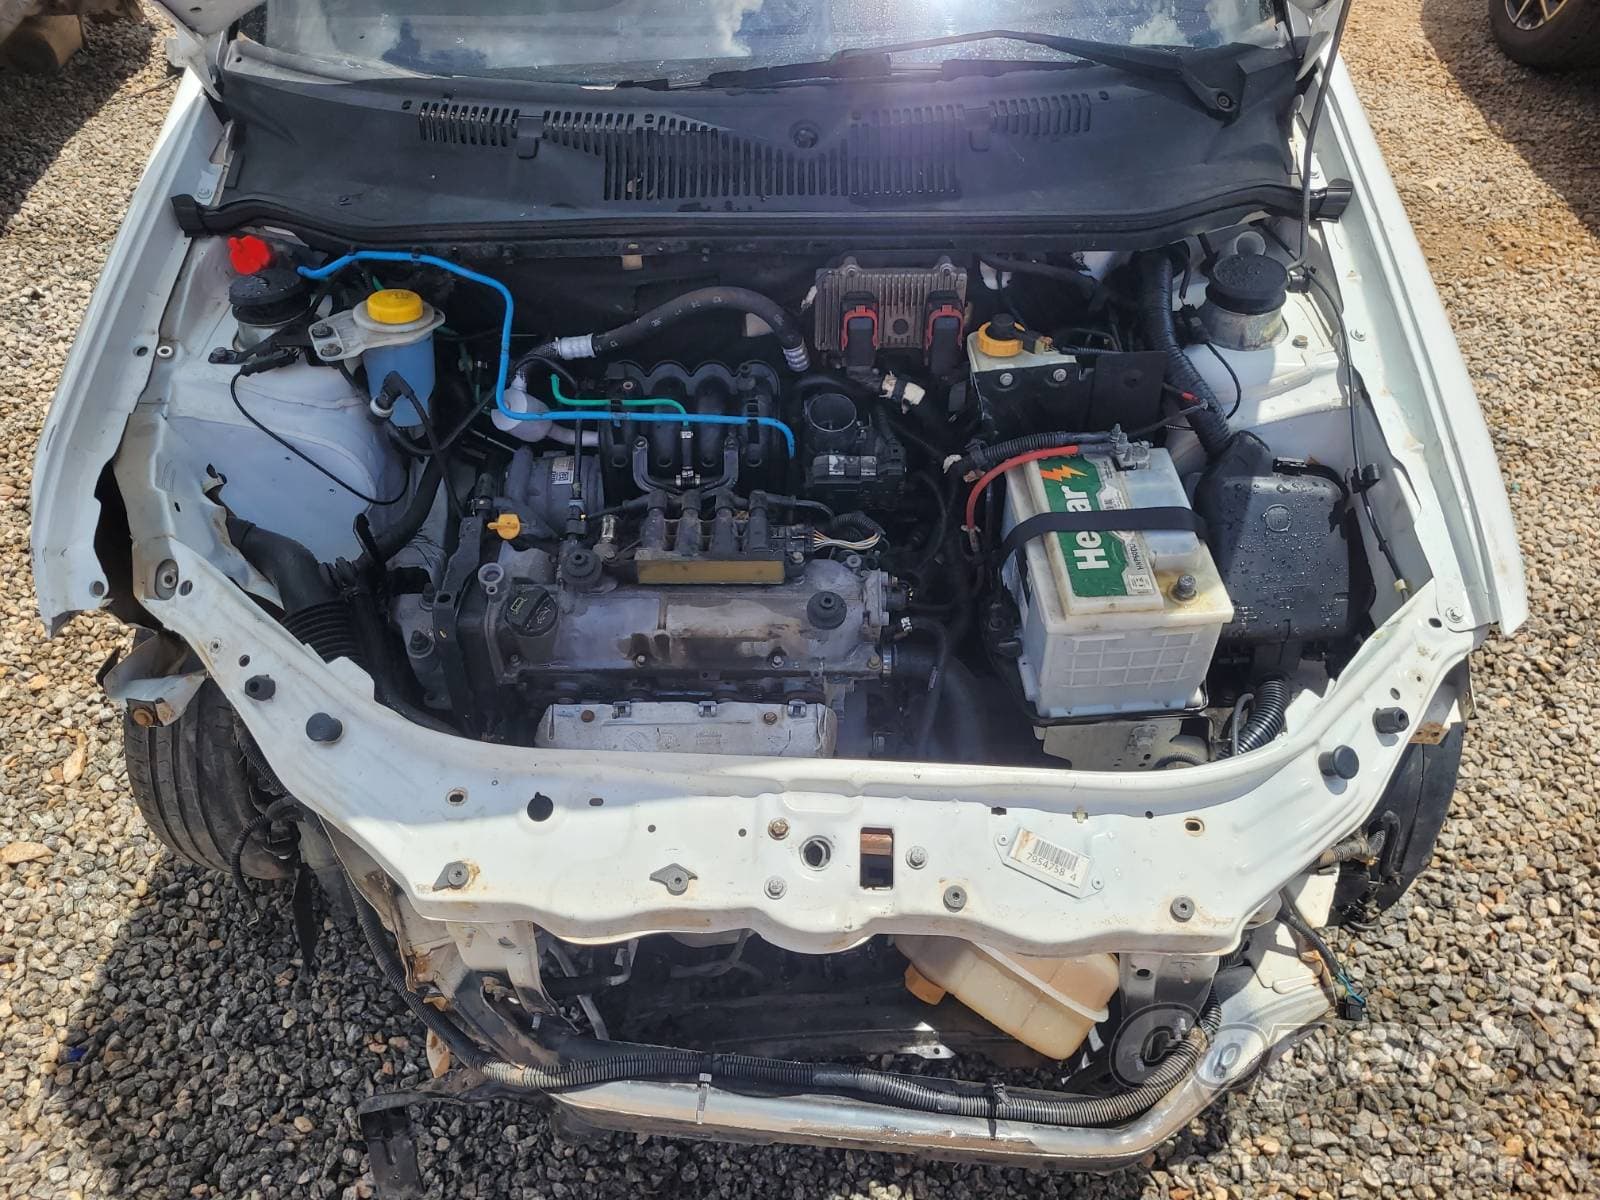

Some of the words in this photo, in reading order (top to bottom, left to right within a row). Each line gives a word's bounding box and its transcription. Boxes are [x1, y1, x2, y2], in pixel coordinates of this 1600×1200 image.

[1060, 484, 1110, 570] Hear
[1026, 851, 1066, 877] 7954758
[1069, 872, 1077, 881] 4
